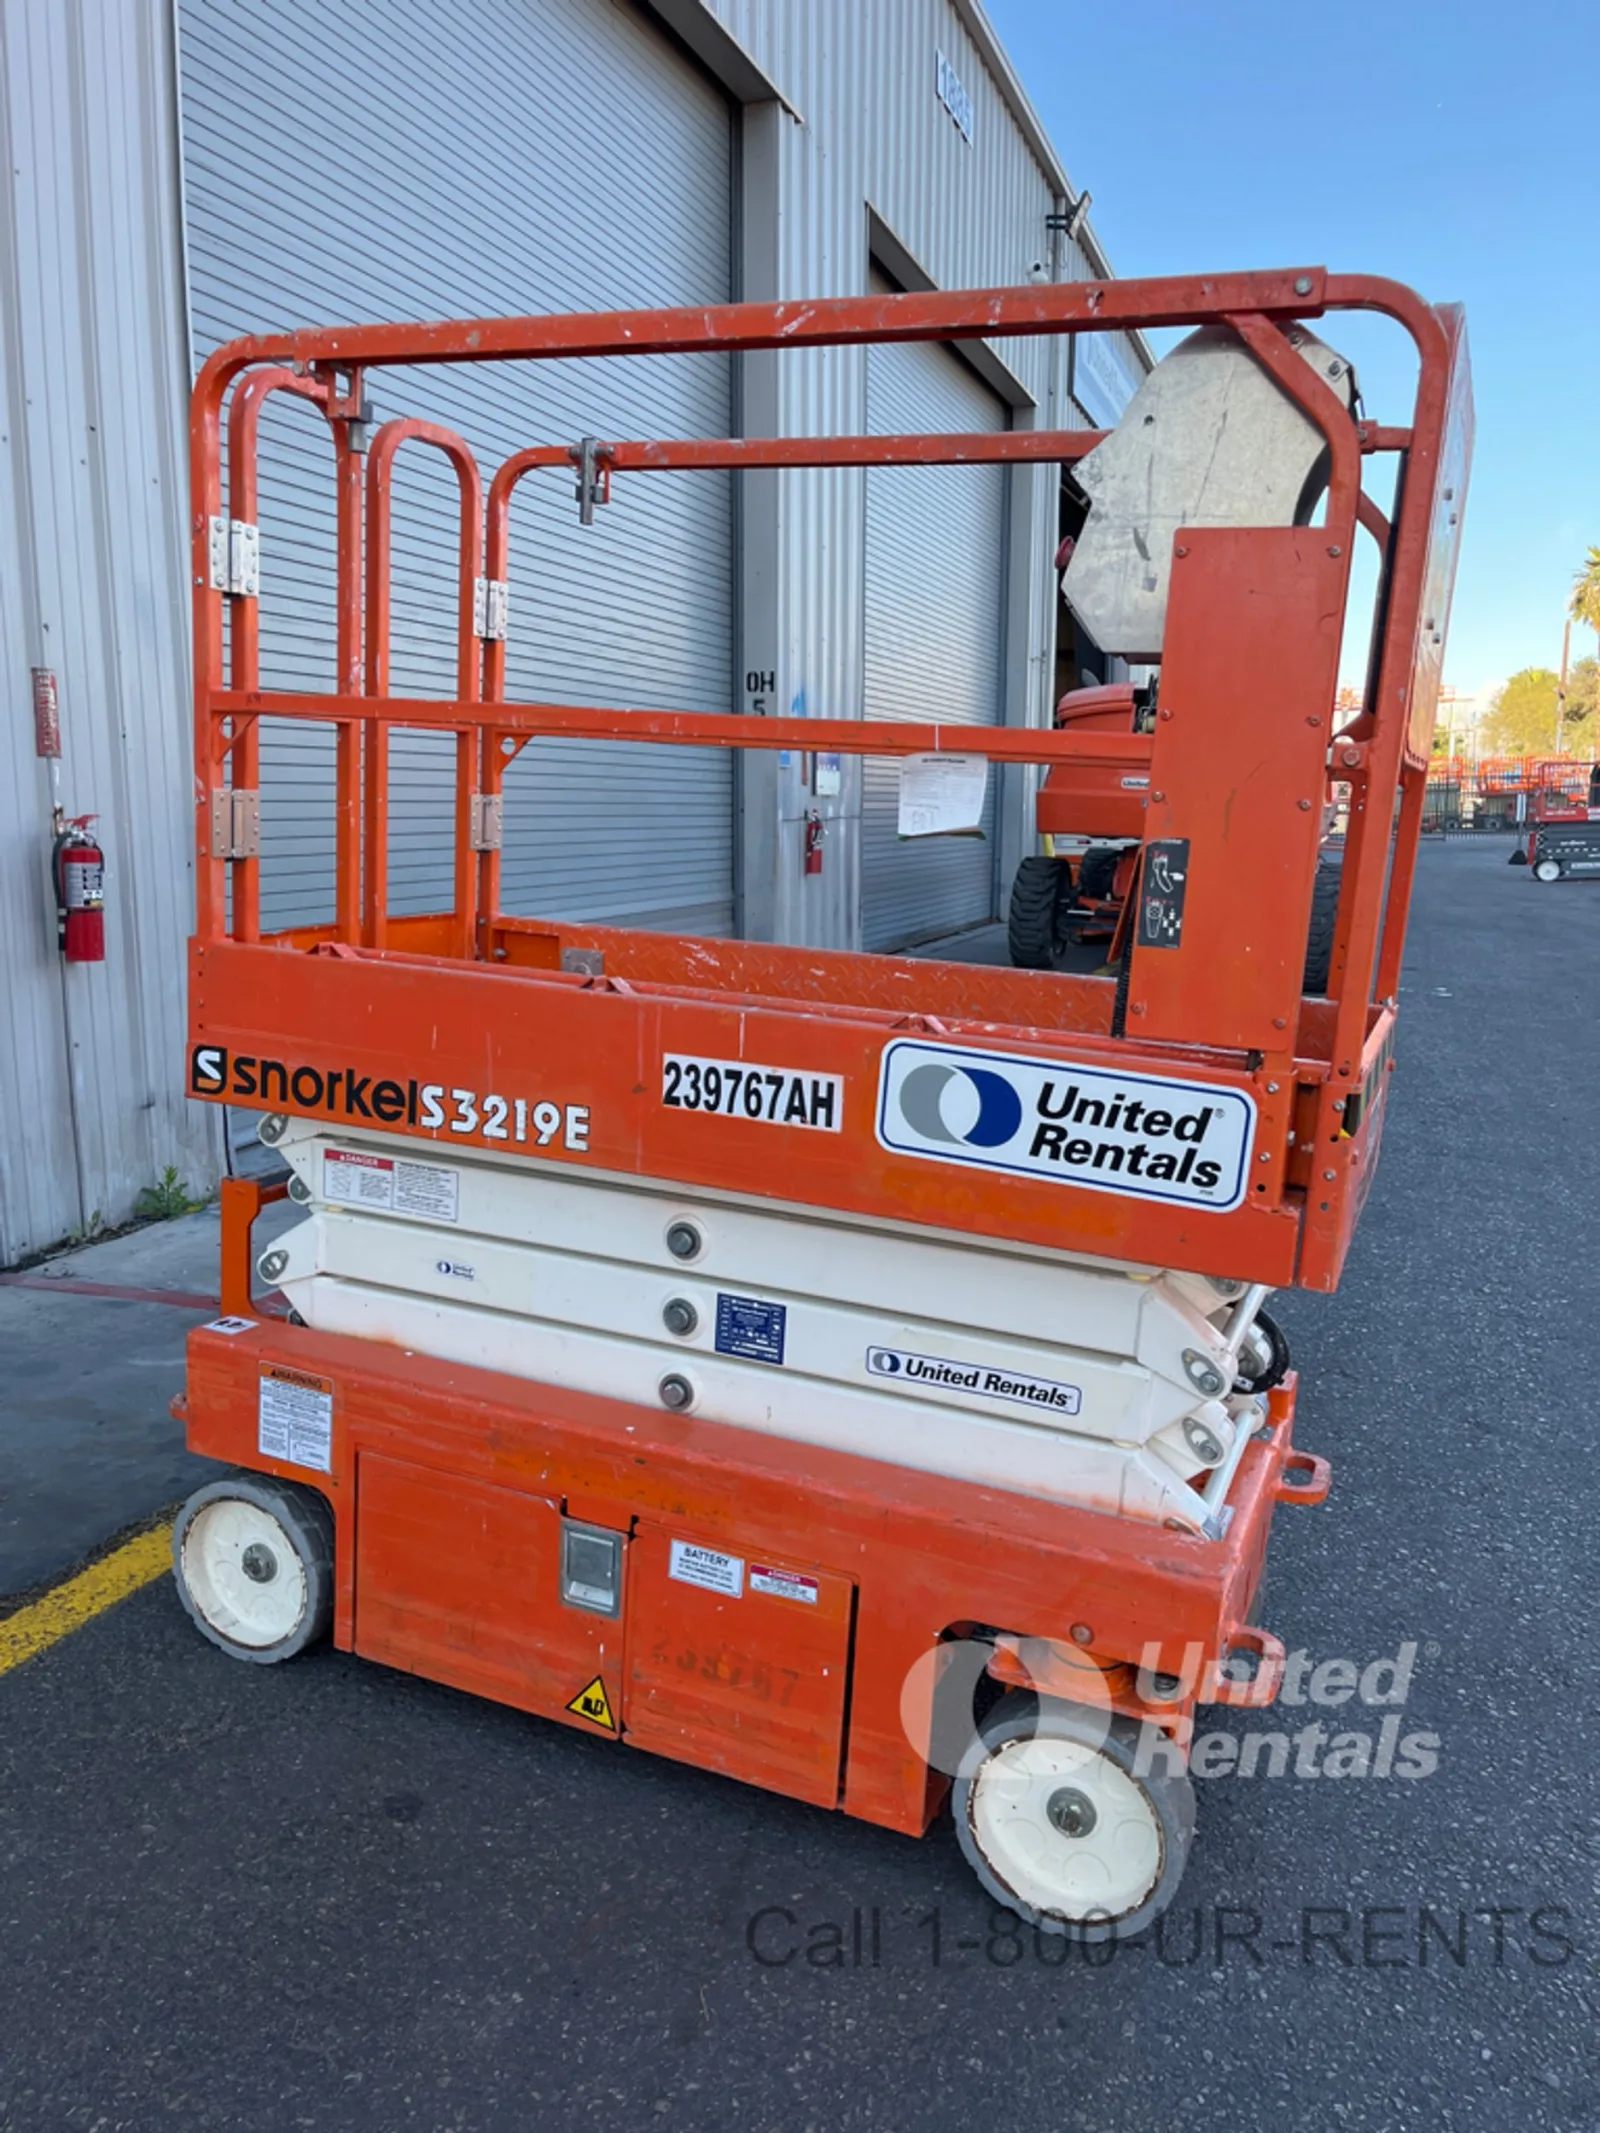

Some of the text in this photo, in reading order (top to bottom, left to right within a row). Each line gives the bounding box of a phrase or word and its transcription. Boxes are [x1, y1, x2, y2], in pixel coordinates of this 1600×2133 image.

[232, 1056, 417, 1126] snorkel
[419, 1084, 591, 1152] S3219E
[662, 1060, 835, 1128] 239767AH
[1036, 1081, 1214, 1144] United
[1028, 1122, 1222, 1188] Rentals
[905, 1358, 1068, 1407] United Rentals
[684, 1547, 730, 1567] BATTERY
